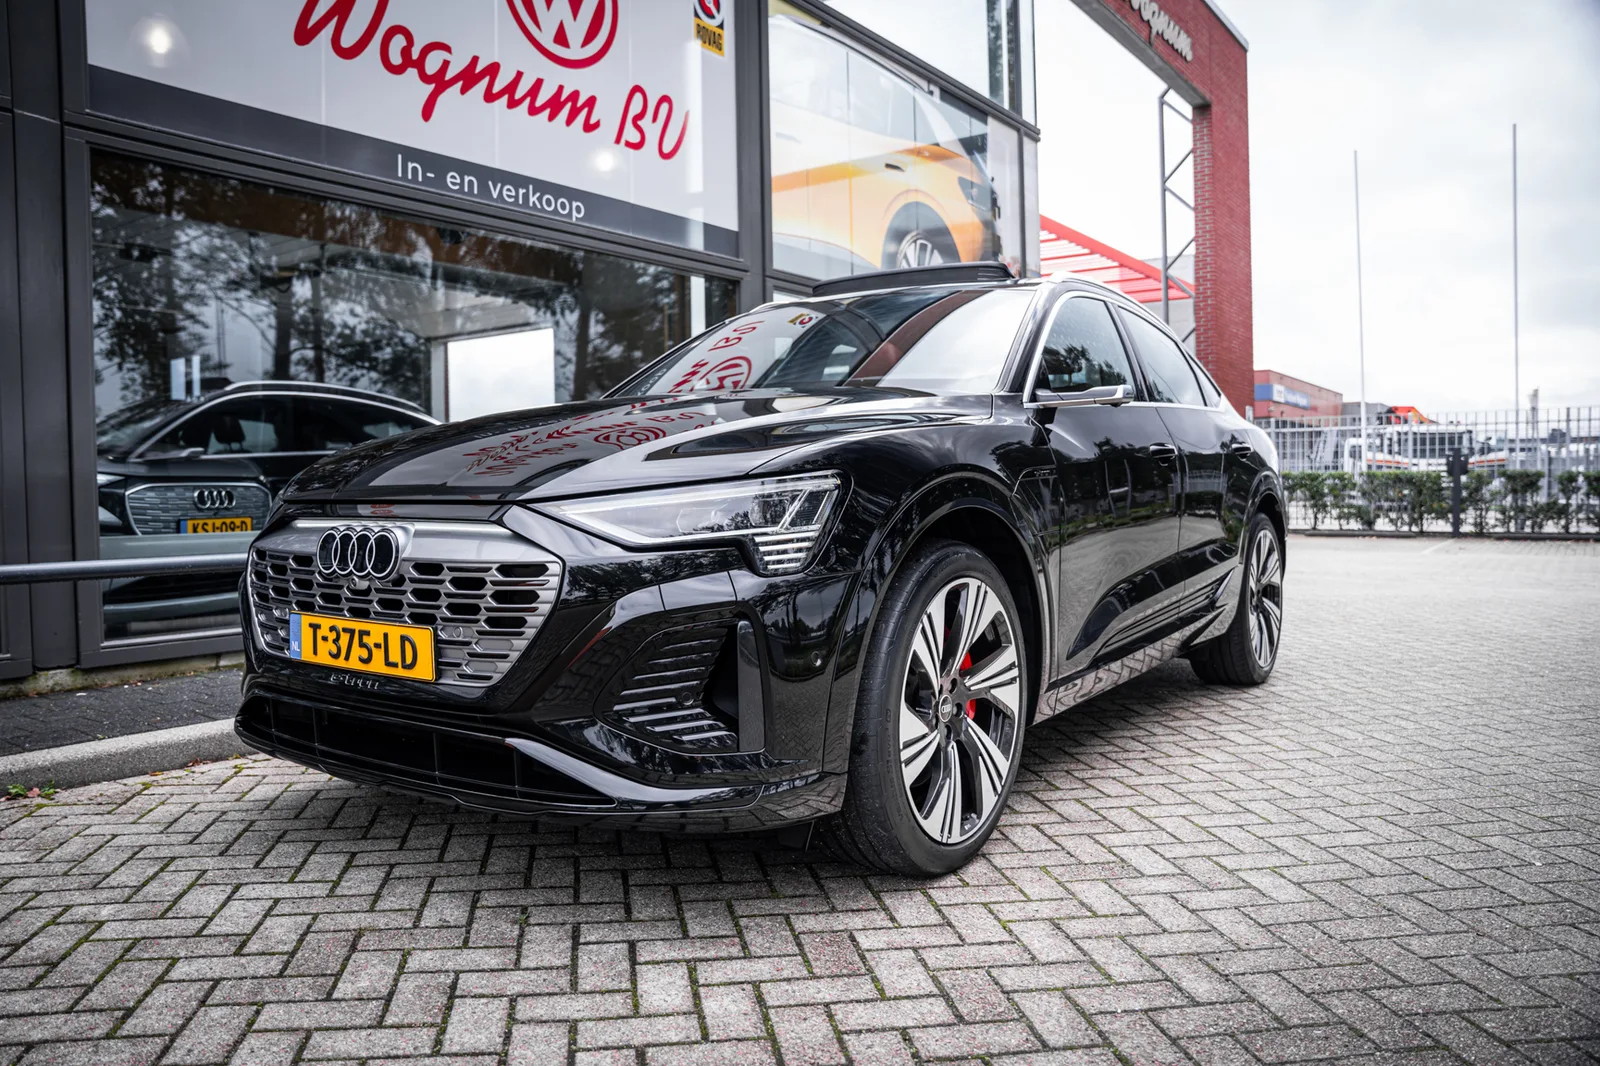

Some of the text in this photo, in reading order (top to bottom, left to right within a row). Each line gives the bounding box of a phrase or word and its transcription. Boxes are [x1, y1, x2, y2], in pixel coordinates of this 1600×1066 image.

[293, 0, 689, 161] Wognum BV
[397, 154, 585, 222] In- en verkoop
[291, 622, 418, 670] NL T-375-LD
